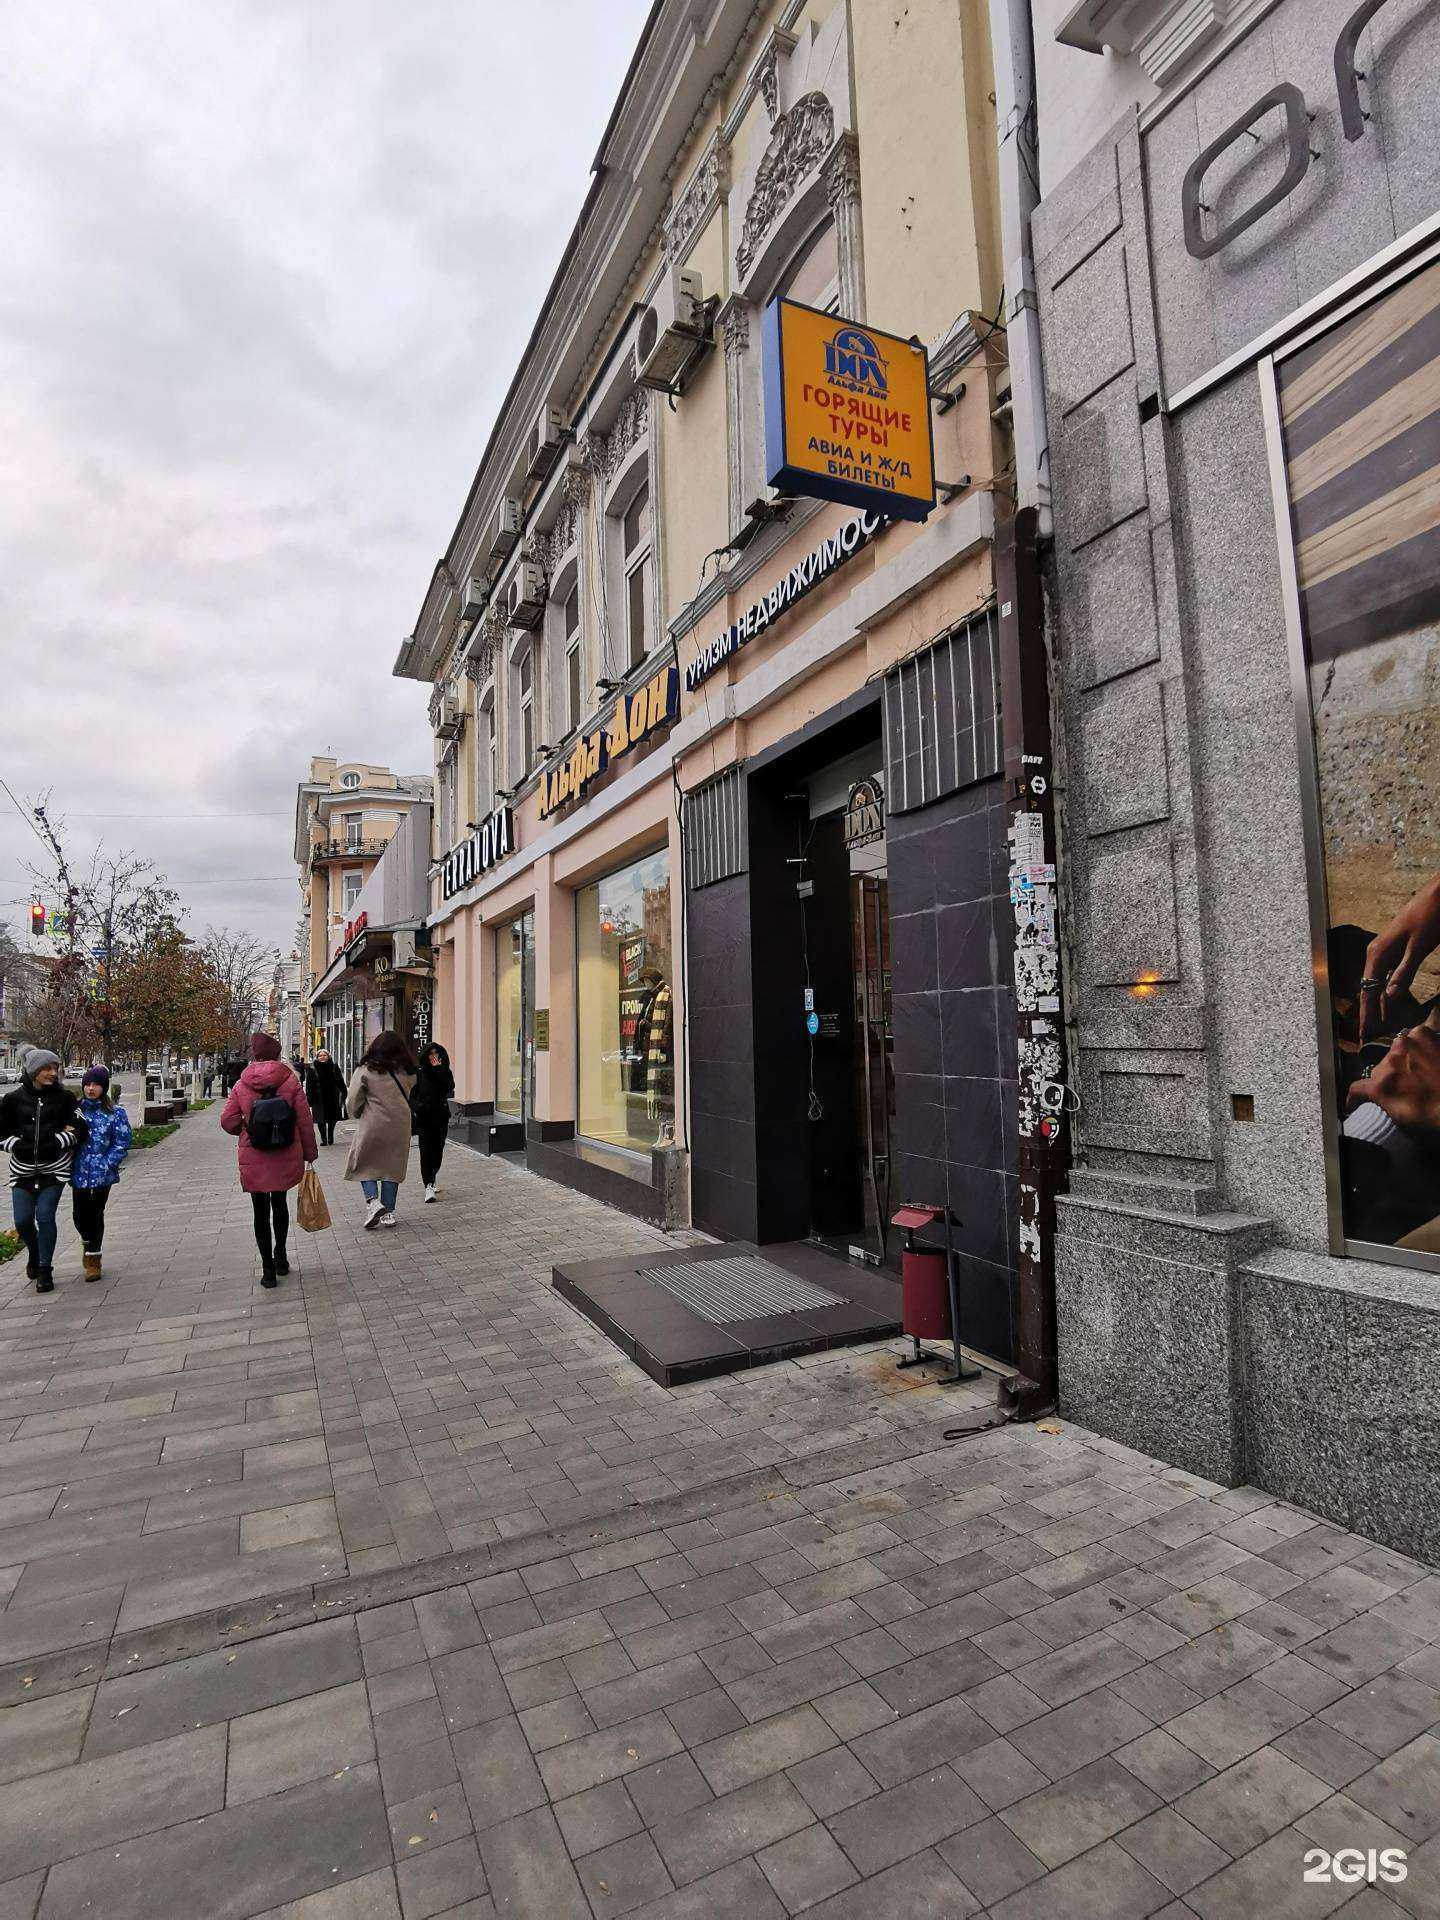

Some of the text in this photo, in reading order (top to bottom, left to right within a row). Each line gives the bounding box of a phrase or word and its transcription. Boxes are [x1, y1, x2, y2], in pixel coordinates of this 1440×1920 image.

[803, 383, 912, 433] ГОРЯЩИЕ
[829, 414, 888, 447] ТУРЫ
[808, 436, 912, 479] АВИА И Ж/Д
[827, 460, 896, 490] БИЛЕТЫ
[737, 507, 889, 644] НЕДВИЖИМОС
